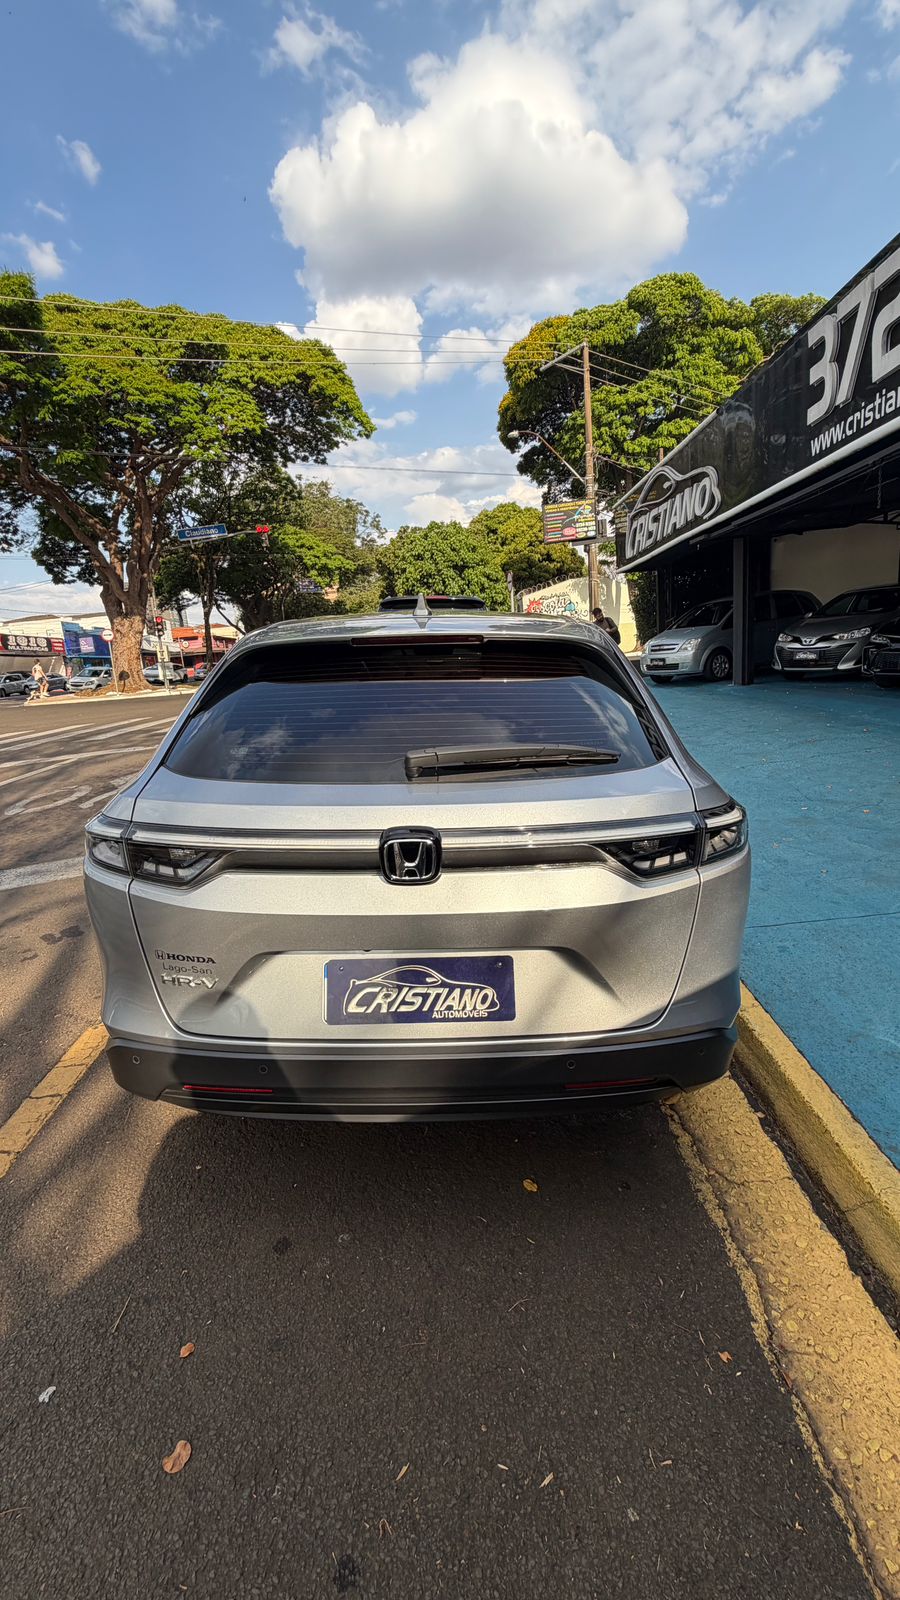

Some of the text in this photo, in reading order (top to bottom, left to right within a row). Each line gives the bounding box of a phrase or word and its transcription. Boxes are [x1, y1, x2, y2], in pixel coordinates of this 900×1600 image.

[625, 476, 712, 560] CRISTIANO
[166, 953, 217, 964] HONDA
[162, 962, 213, 975] Lago-San
[161, 973, 219, 989] HR-V
[347, 986, 494, 1014] CRISTIANO
